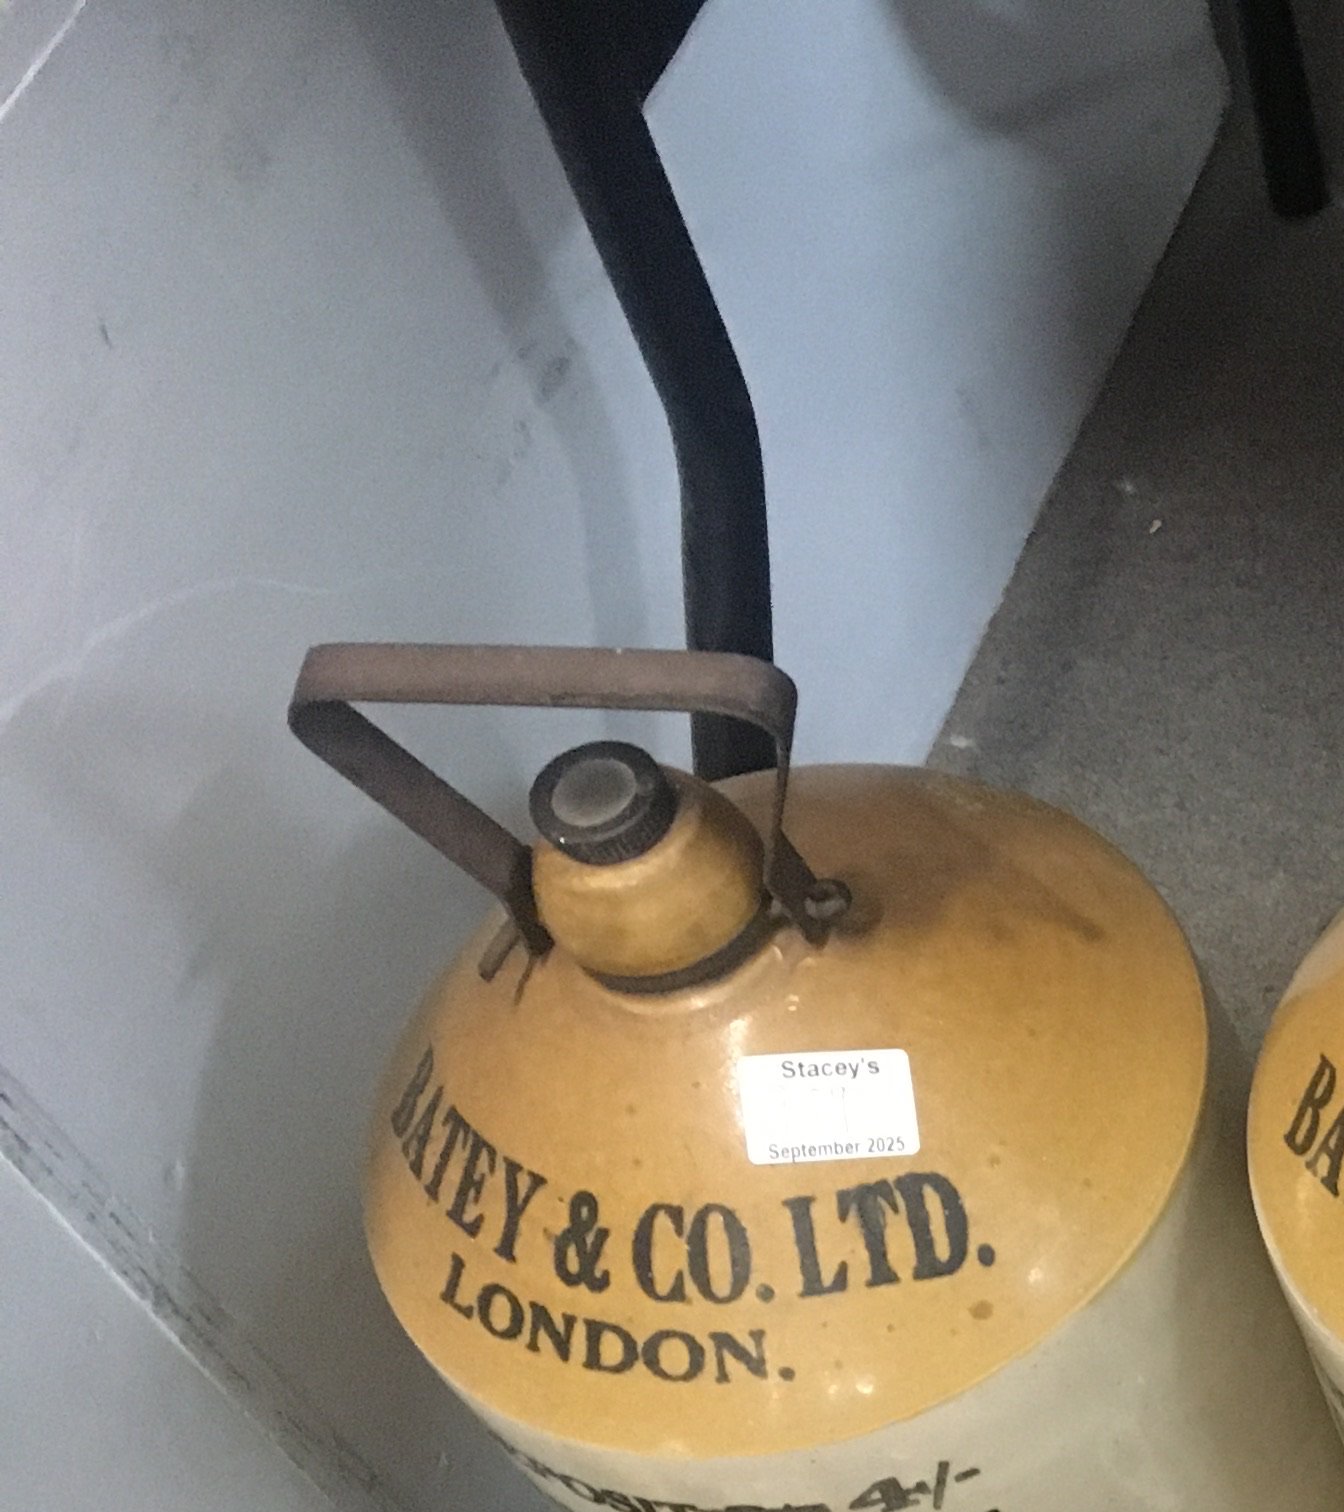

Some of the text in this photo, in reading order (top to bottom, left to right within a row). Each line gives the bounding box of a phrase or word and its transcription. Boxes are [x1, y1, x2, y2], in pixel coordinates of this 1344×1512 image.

[780, 1057, 880, 1079] Stacey's
[391, 1043, 996, 1305] BATEY & CO. LTD.
[768, 1136, 905, 1164] September 2025
[439, 1253, 796, 1384] LONDON.
